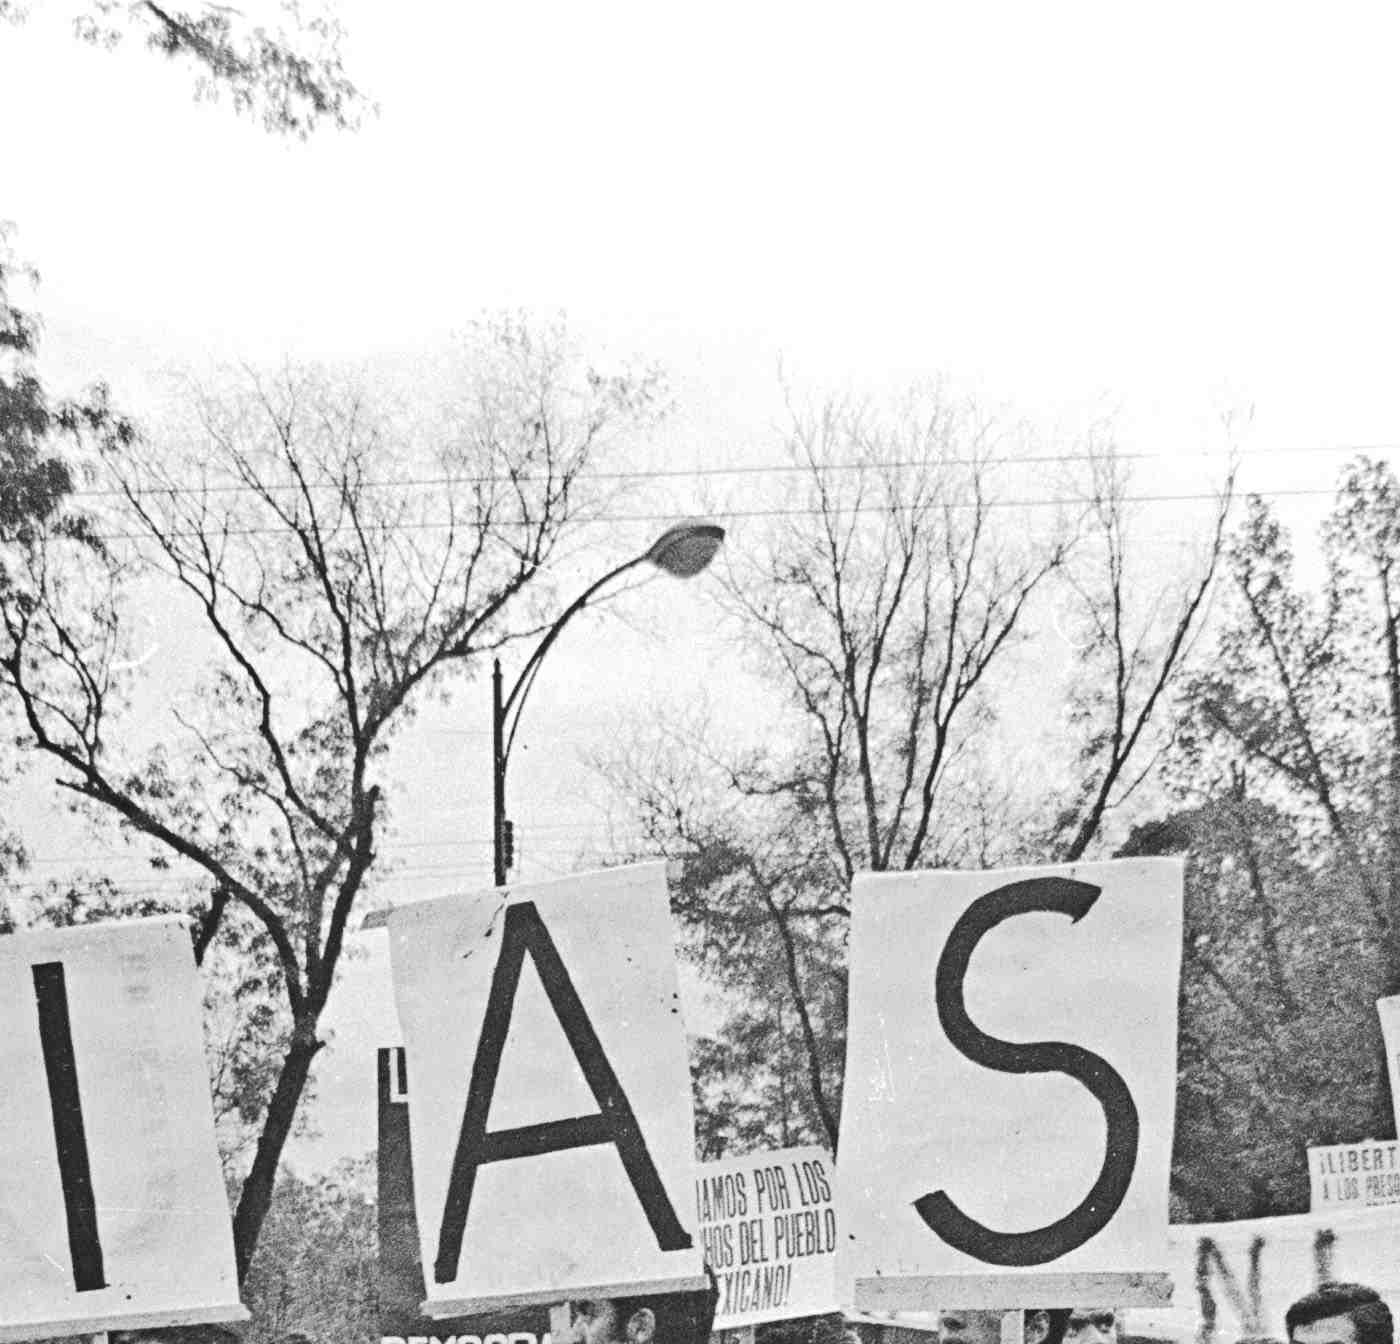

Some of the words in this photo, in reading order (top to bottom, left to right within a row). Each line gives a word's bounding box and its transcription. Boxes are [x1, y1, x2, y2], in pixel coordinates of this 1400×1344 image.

[695, 1171, 749, 1223] AMOS
[753, 1165, 791, 1214] POR
[792, 1159, 832, 1207] LOS
[1336, 1176, 1361, 1201] LOS
[738, 1218, 769, 1266] DEL
[773, 1207, 836, 1261] PUEBLO
